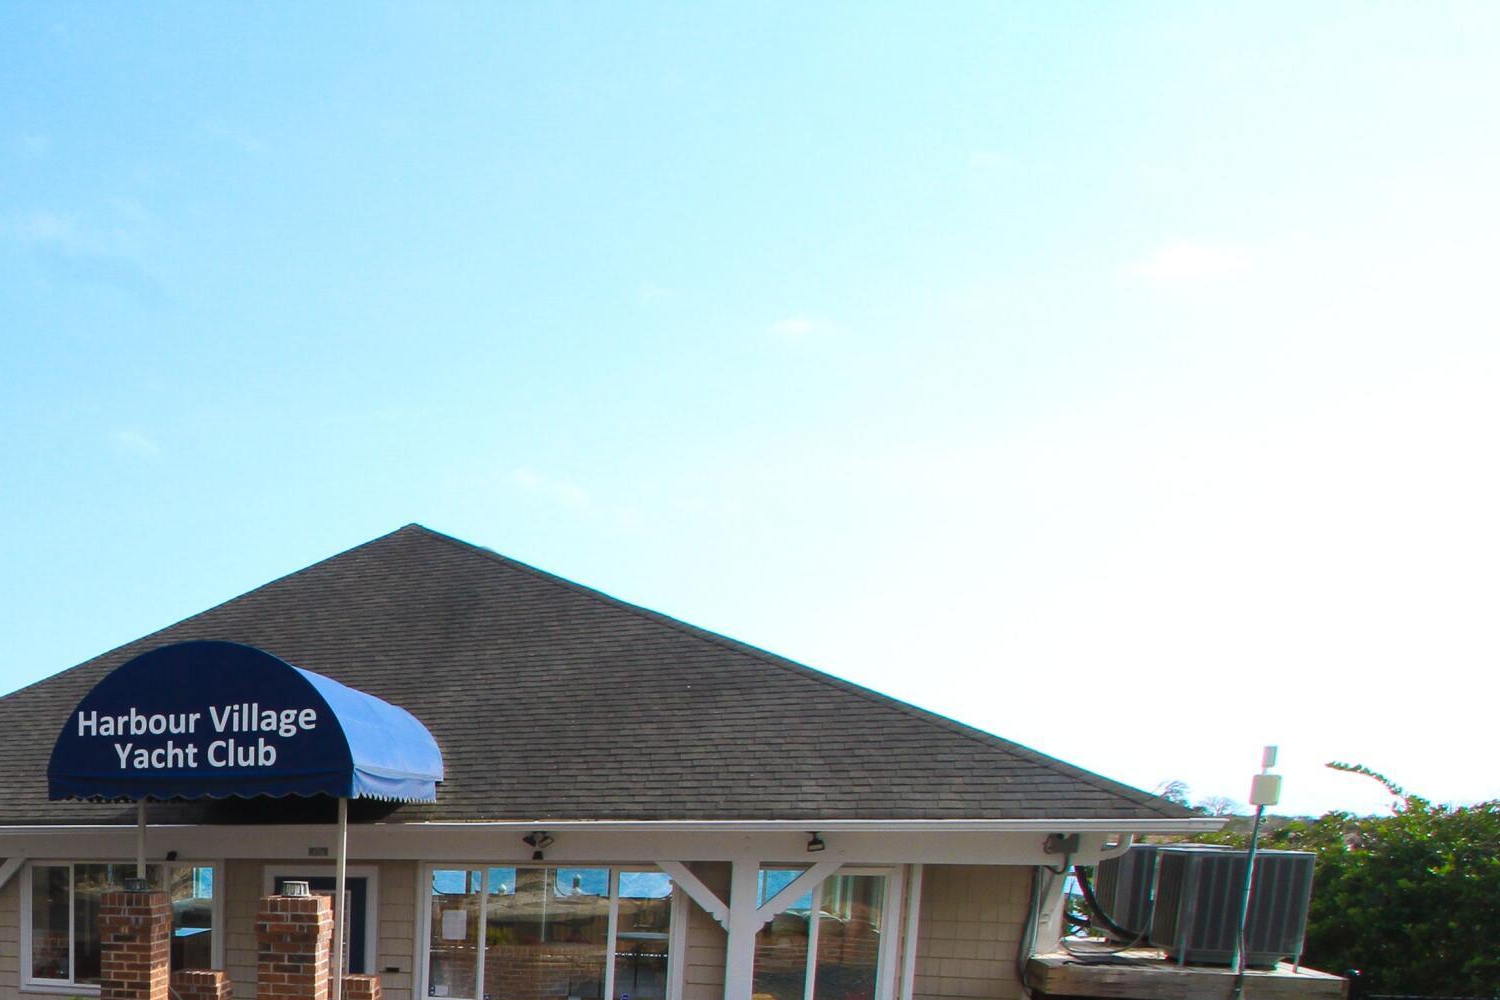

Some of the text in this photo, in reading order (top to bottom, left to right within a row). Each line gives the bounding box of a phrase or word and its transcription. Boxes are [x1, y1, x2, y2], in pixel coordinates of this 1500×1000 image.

[78, 703, 317, 737] Harbour Village
[115, 738, 277, 769] Yacht Club
